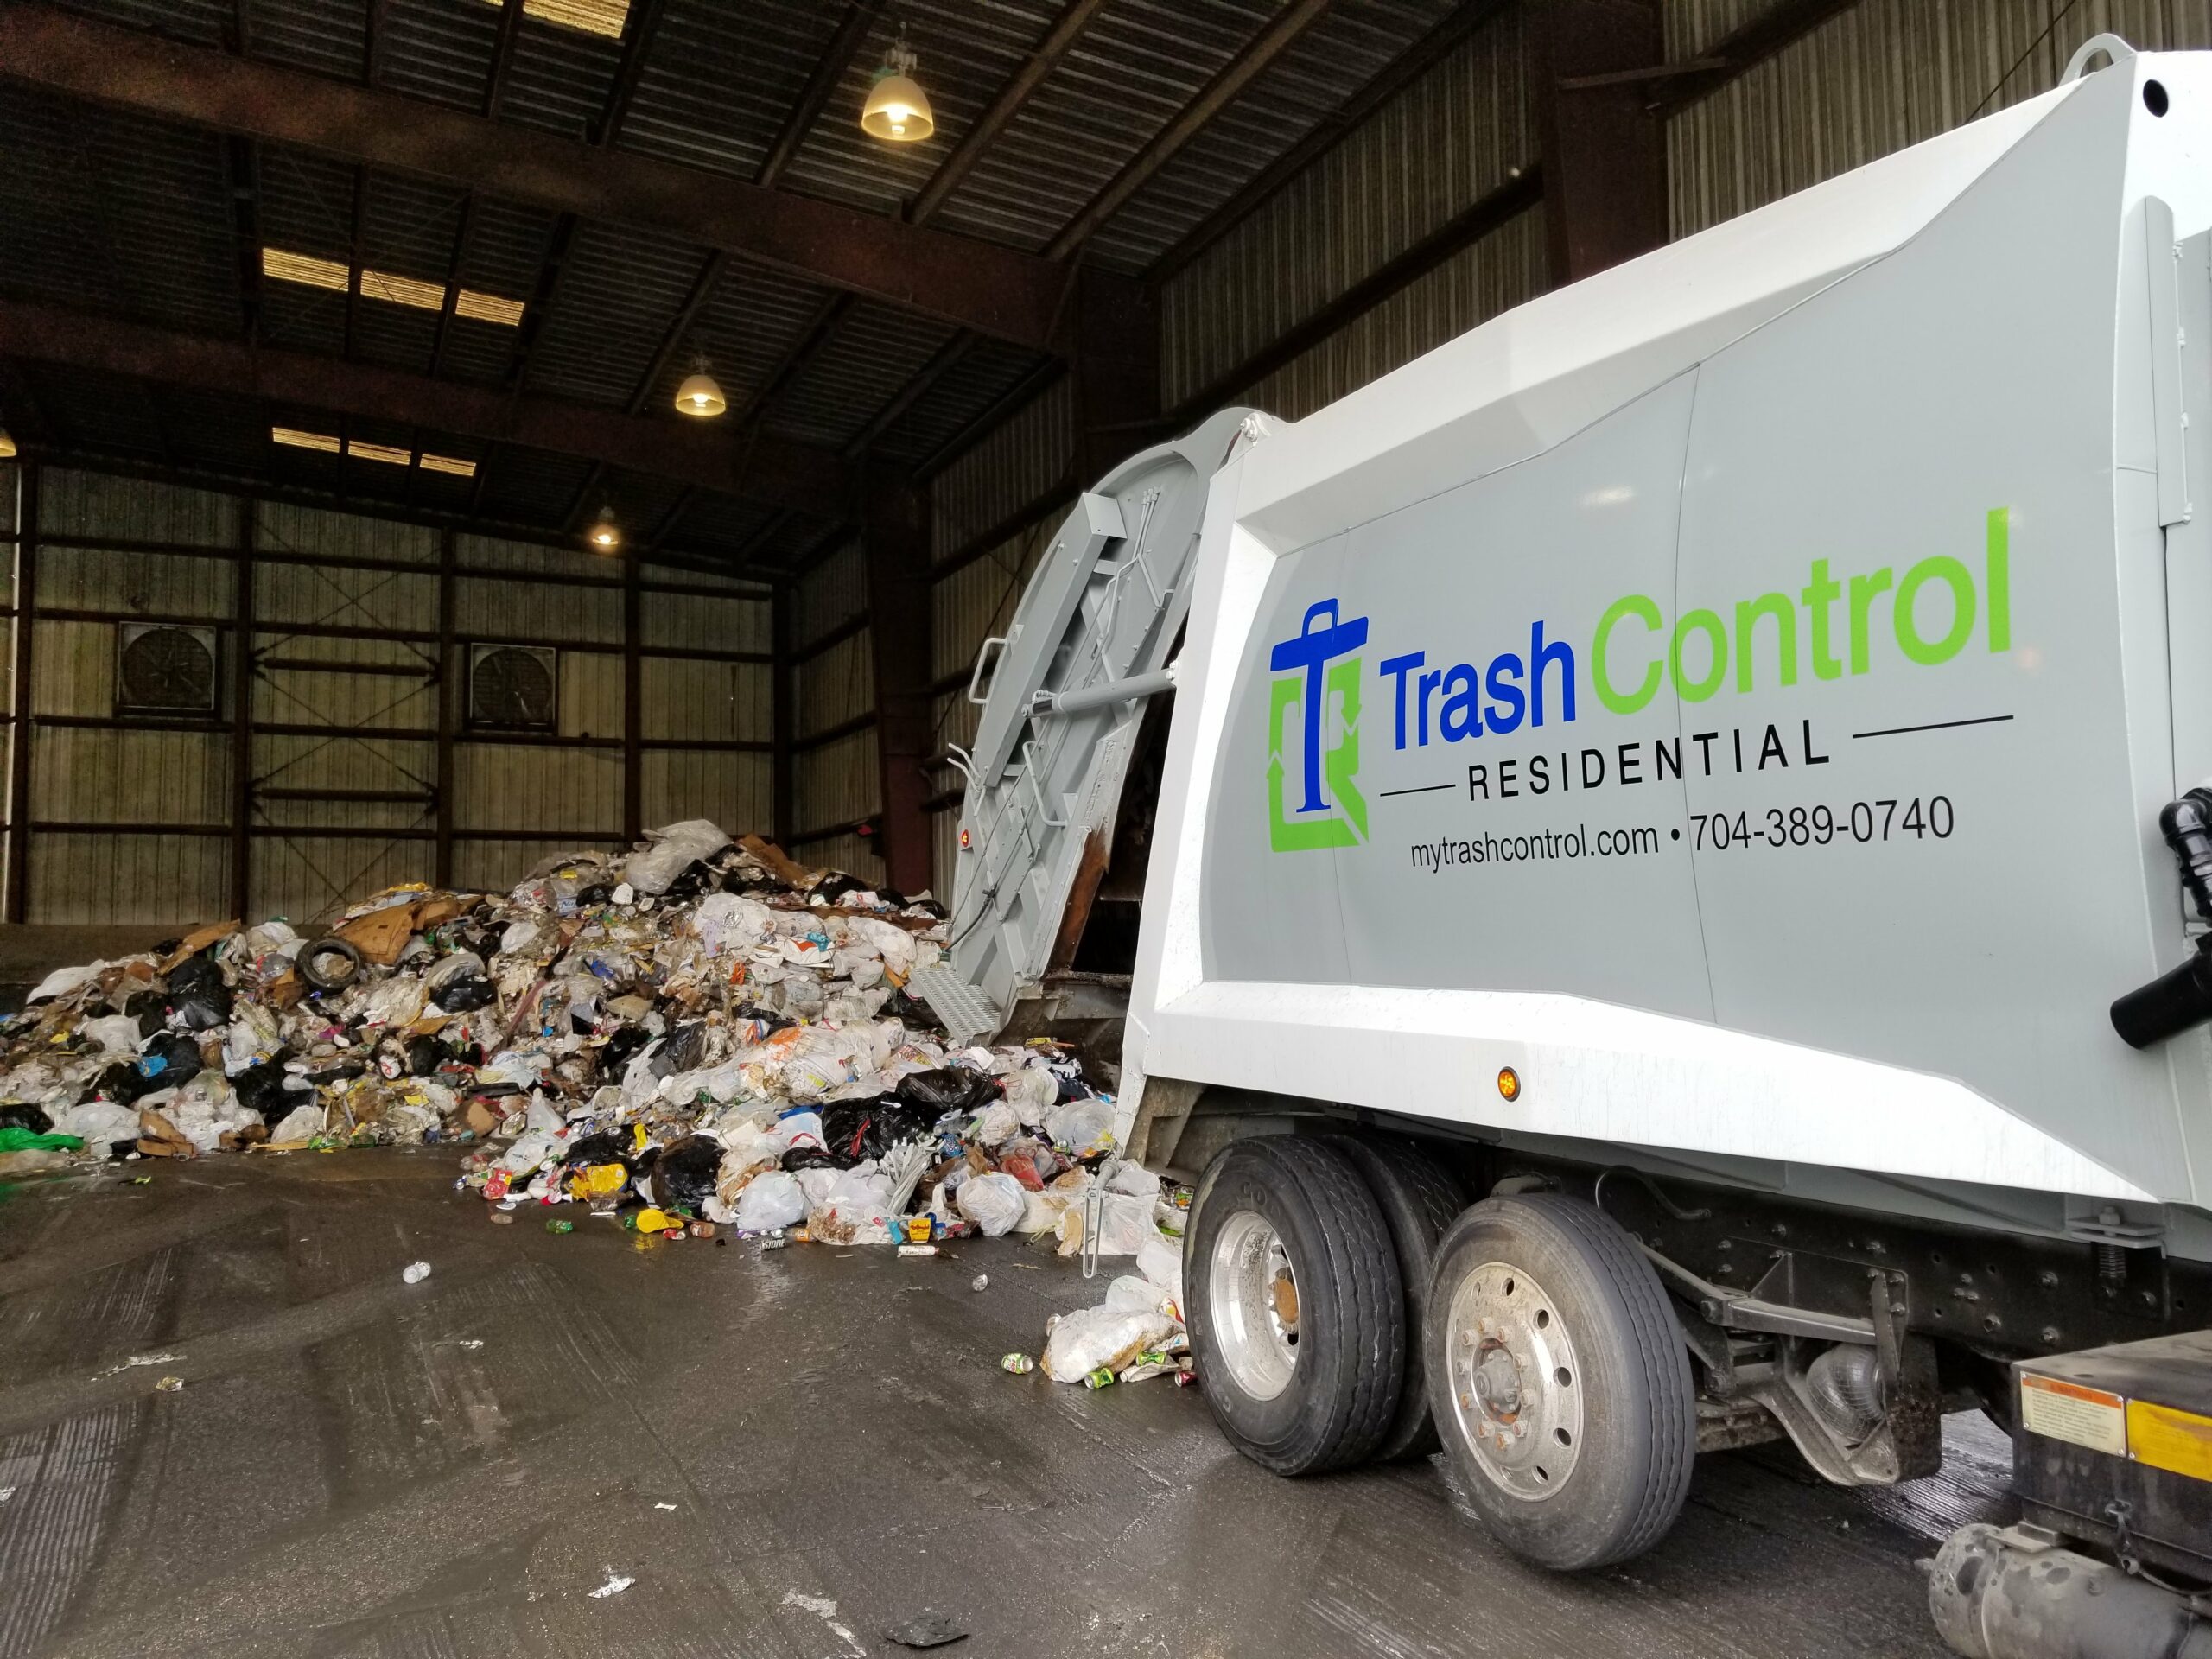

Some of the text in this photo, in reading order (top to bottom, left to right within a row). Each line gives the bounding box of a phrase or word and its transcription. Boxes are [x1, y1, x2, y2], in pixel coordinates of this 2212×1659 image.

[1379, 507, 2011, 751] Trash Control
[1469, 720, 1830, 802] RESIDENTIAL
[1412, 795, 1954, 874] mytrashcontrol.com 704-389-0740
